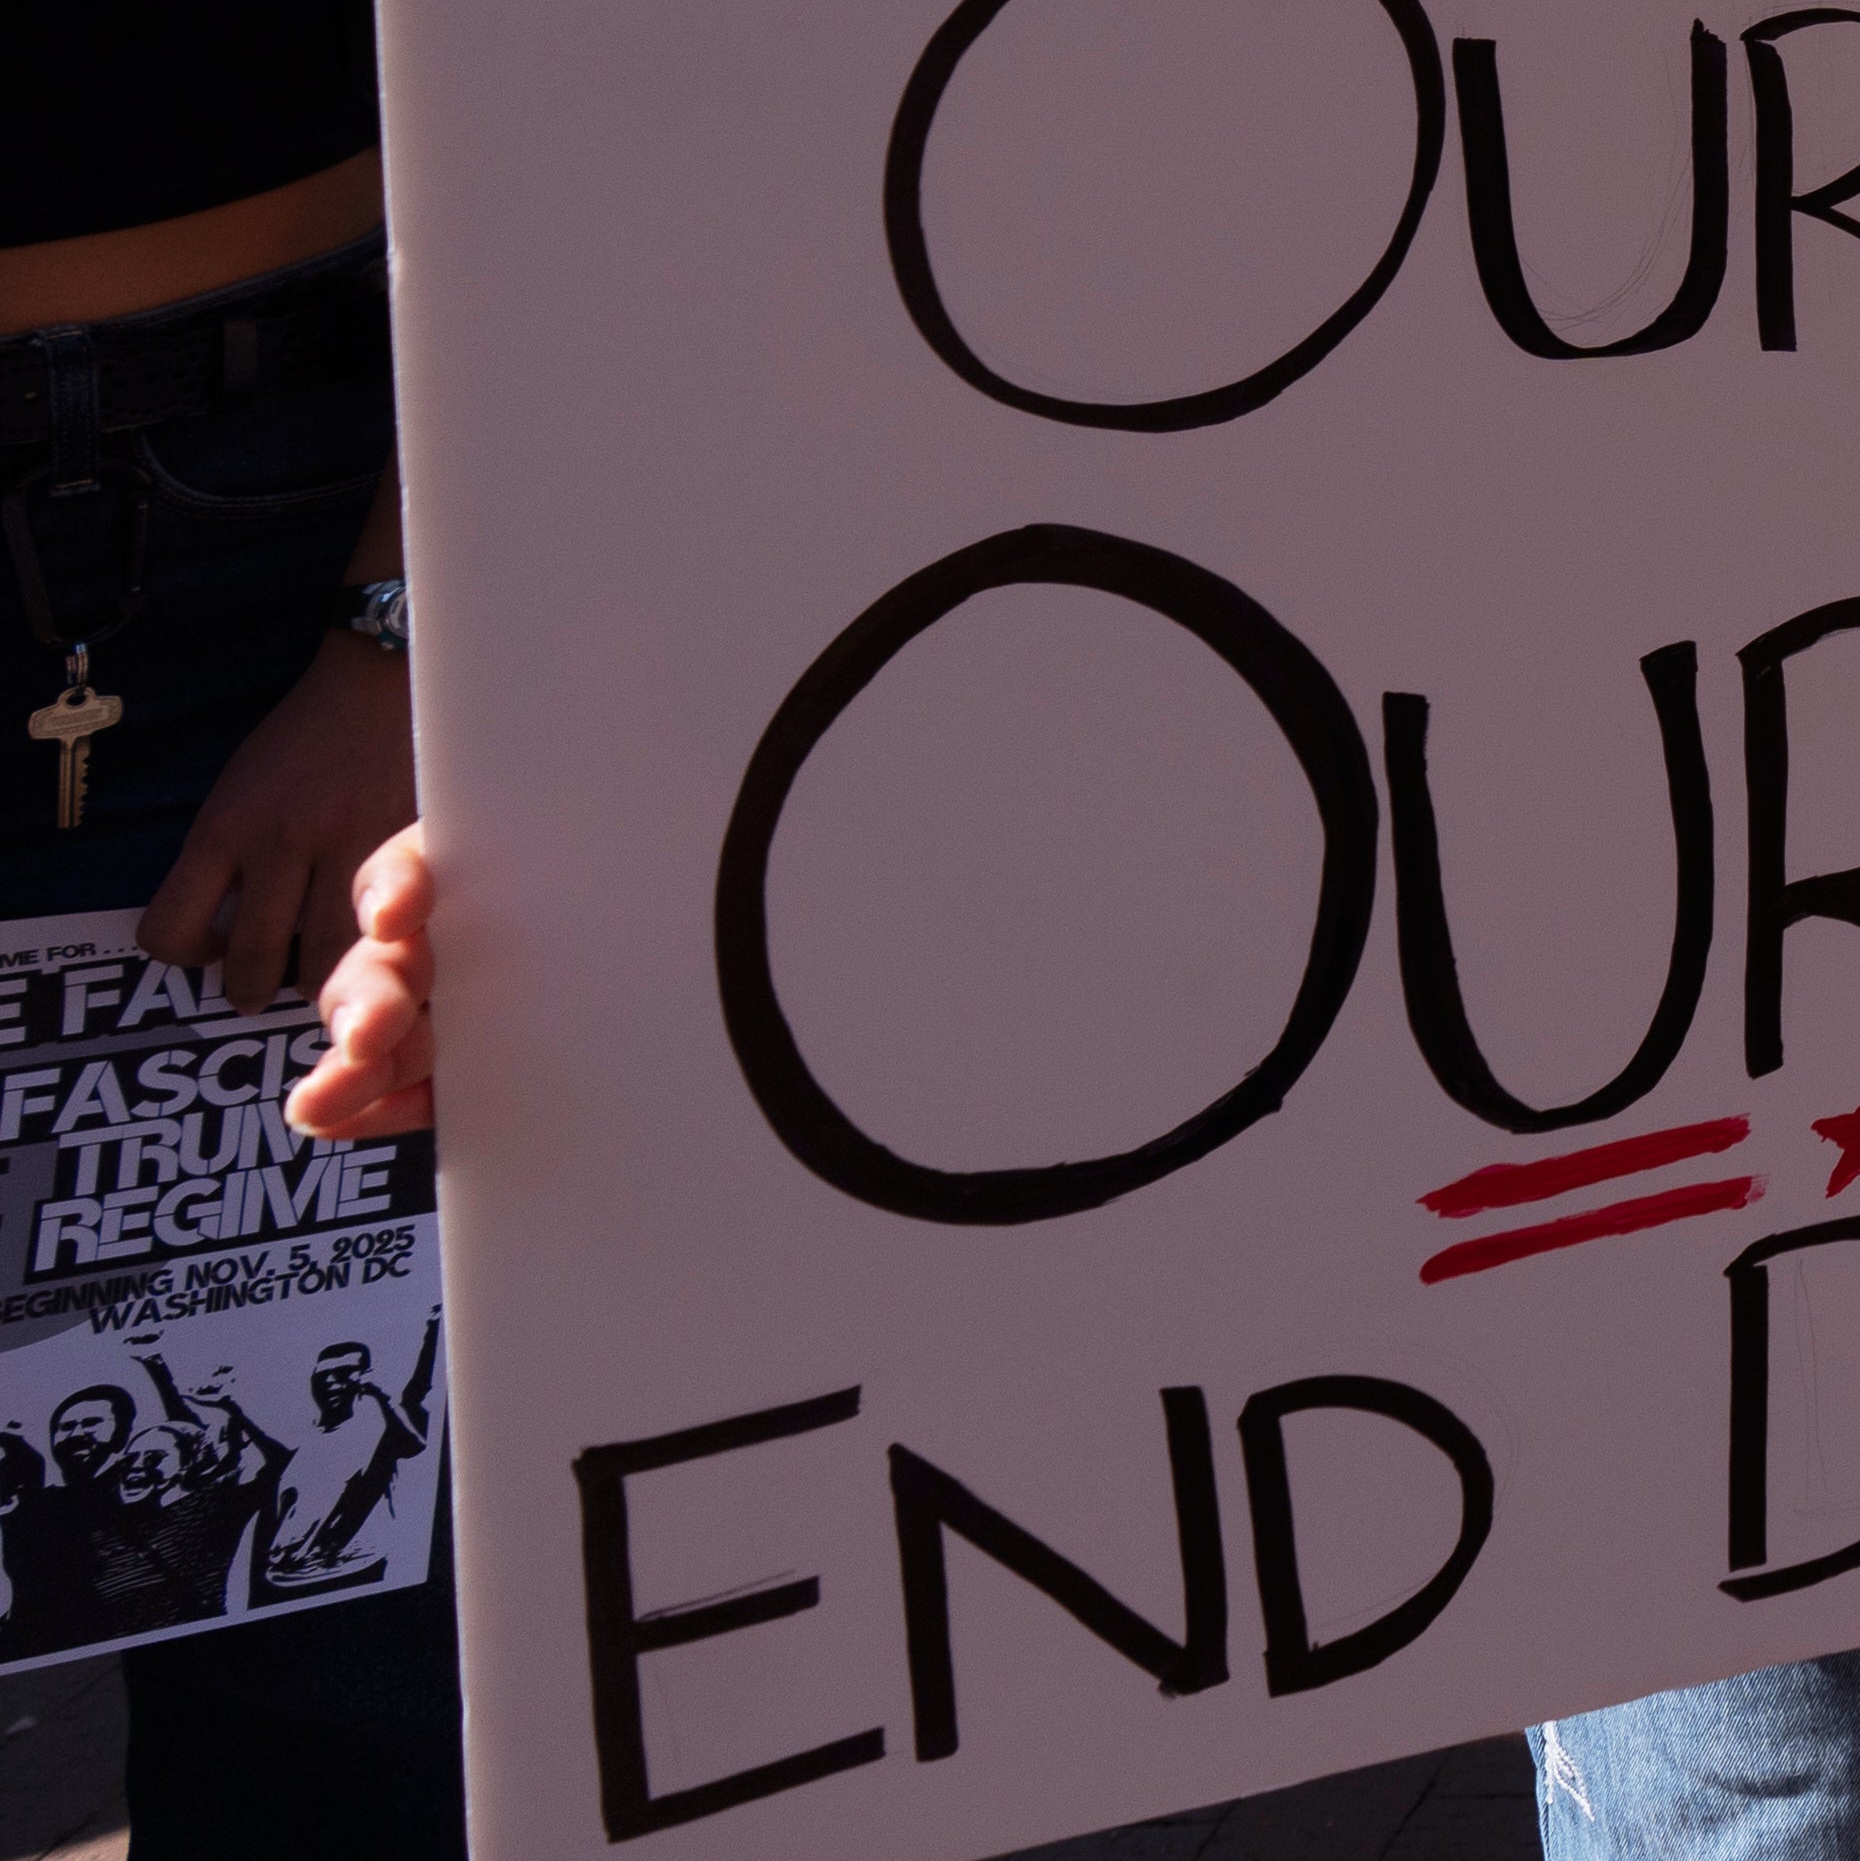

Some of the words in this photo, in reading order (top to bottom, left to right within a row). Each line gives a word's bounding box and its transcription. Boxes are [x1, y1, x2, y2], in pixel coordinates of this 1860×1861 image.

[58, 1100, 356, 1198] TRUM
[33, 1144, 398, 1273] REGIME
[0, 1267, 174, 1325] EGINNING
[185, 1250, 277, 1289] NOV.
[331, 1223, 417, 1264] 2025
[88, 1260, 353, 1335] WASHINGTON
[361, 1250, 414, 1285] DC
[573, 1384, 1495, 1844] END
